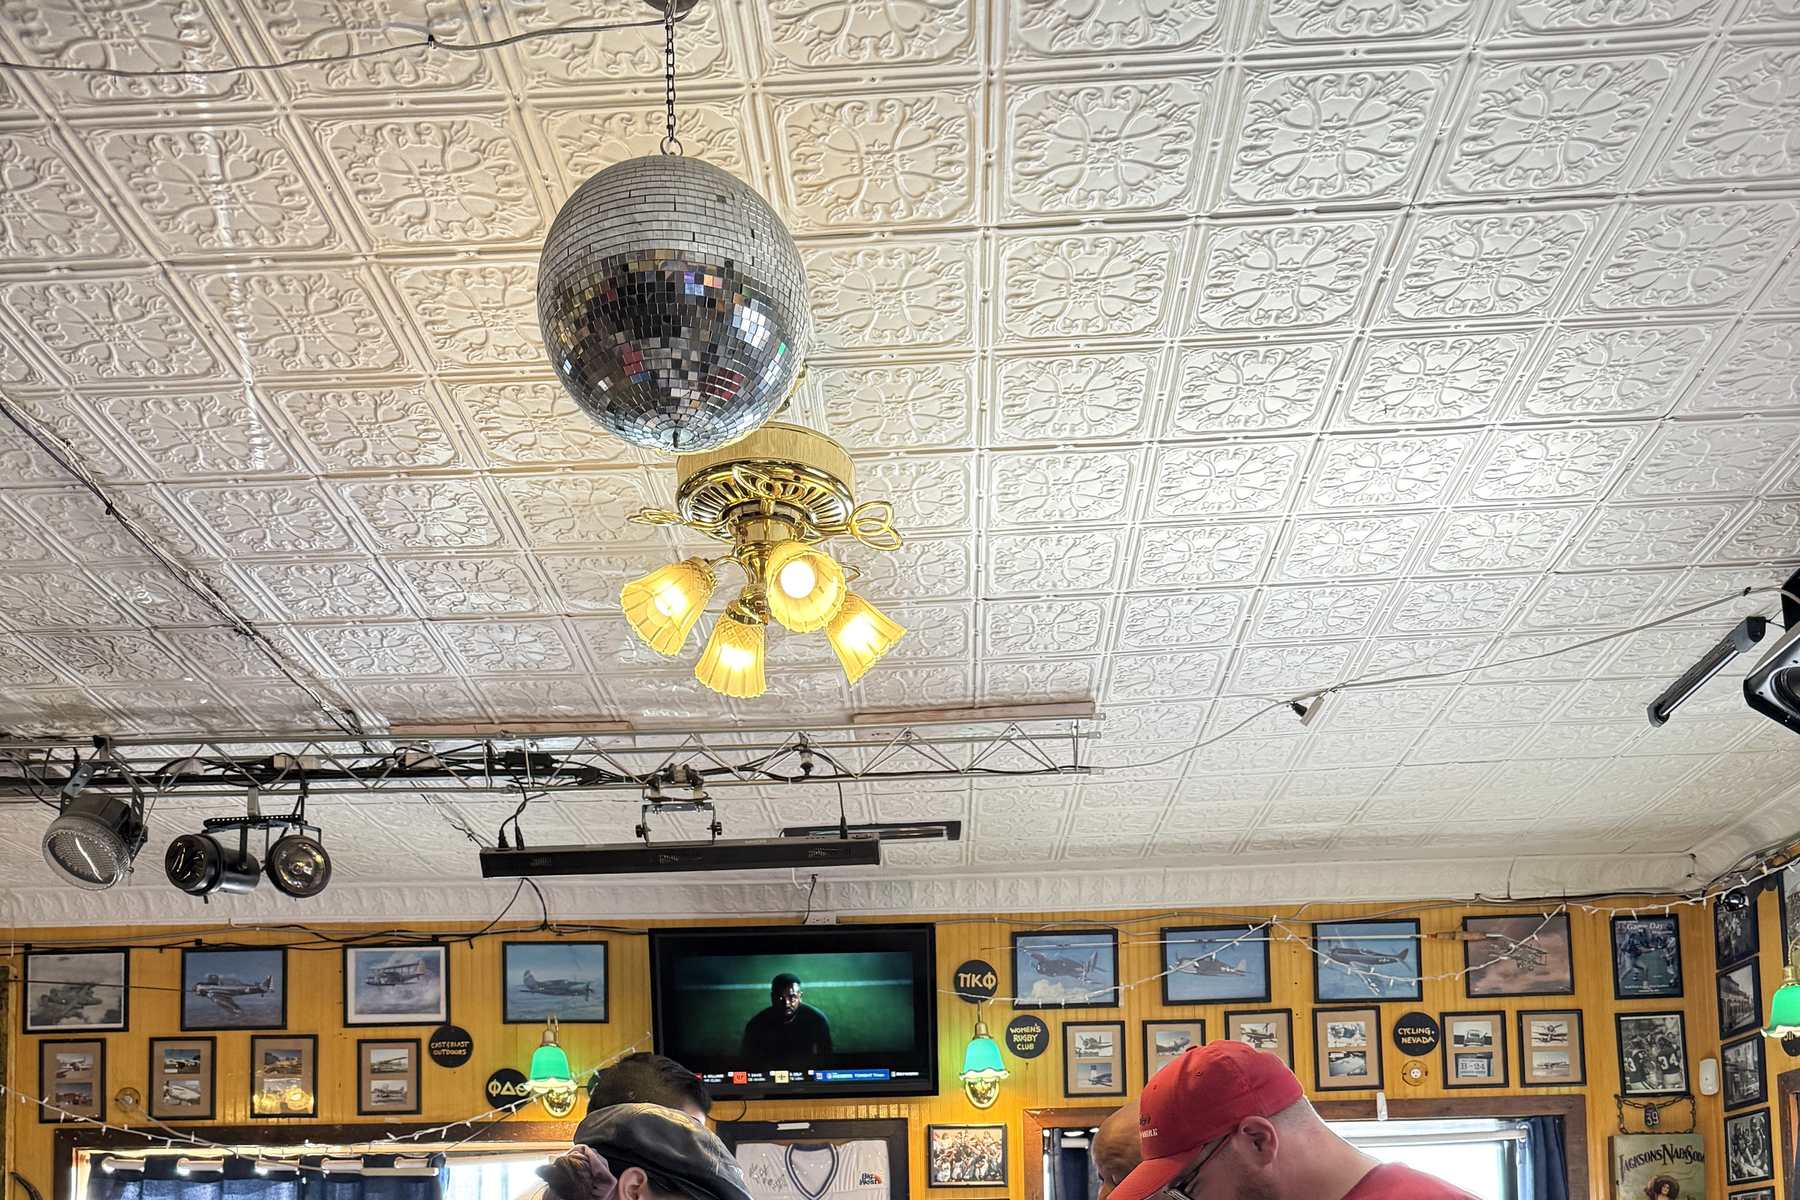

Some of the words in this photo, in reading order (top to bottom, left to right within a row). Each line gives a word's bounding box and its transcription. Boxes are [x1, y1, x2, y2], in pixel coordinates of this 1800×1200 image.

[1009, 1023, 1041, 1034] WOMEN'S
[1013, 1033, 1038, 1043] RUGBY
[1401, 1036, 1435, 1045] NEVADA
[1016, 1043, 1035, 1051] CLUB
[1658, 1053, 1679, 1071] 34
